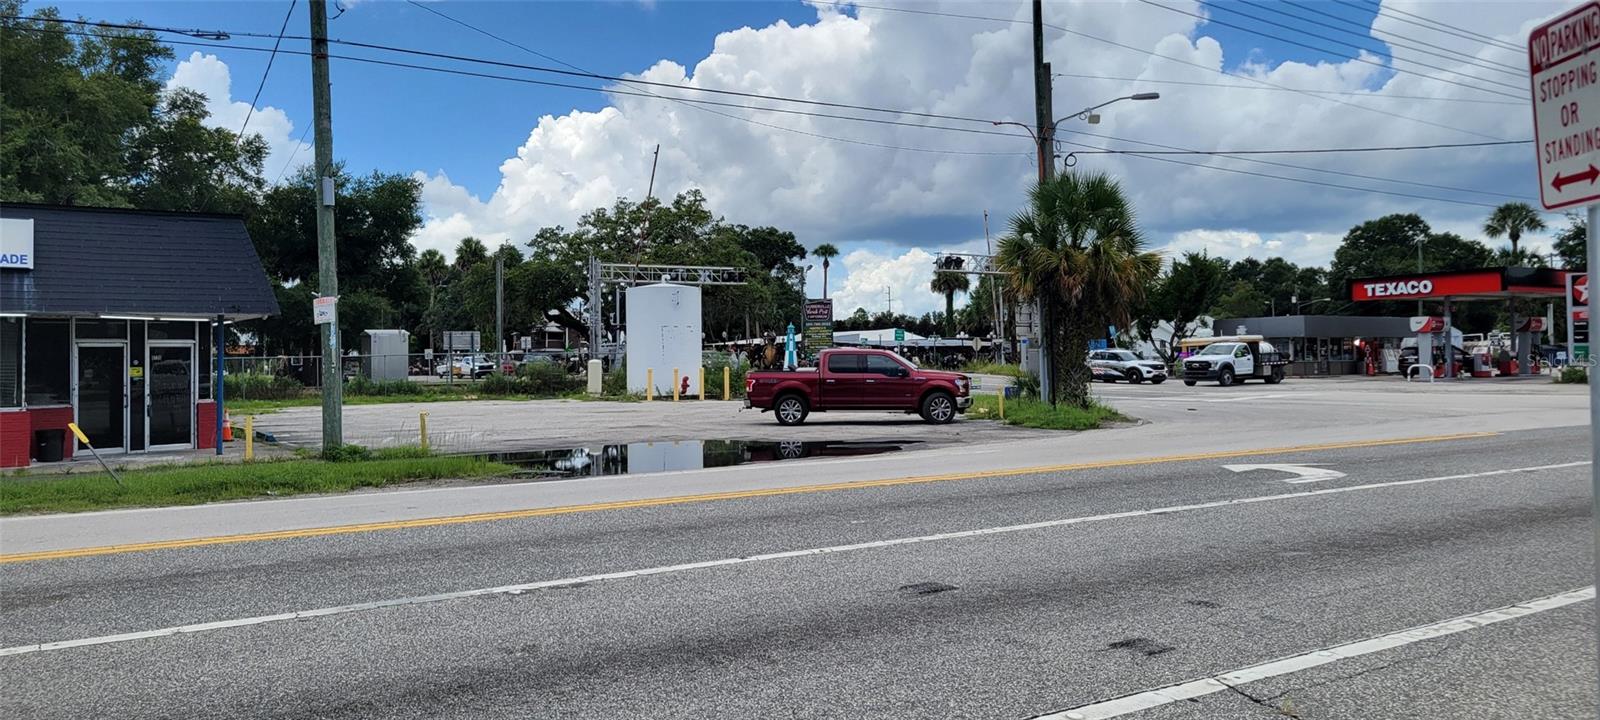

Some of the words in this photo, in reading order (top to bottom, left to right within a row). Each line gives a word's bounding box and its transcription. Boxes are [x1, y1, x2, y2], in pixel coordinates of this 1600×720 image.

[1532, 35, 1548, 67] NO
[1550, 11, 1600, 60] PARKING
[1540, 60, 1597, 103] STOPPING
[1560, 101, 1580, 127] OR
[1545, 126, 1600, 164] STANDING
[0, 254, 28, 265] ADE
[1364, 280, 1433, 297] TEXACO
